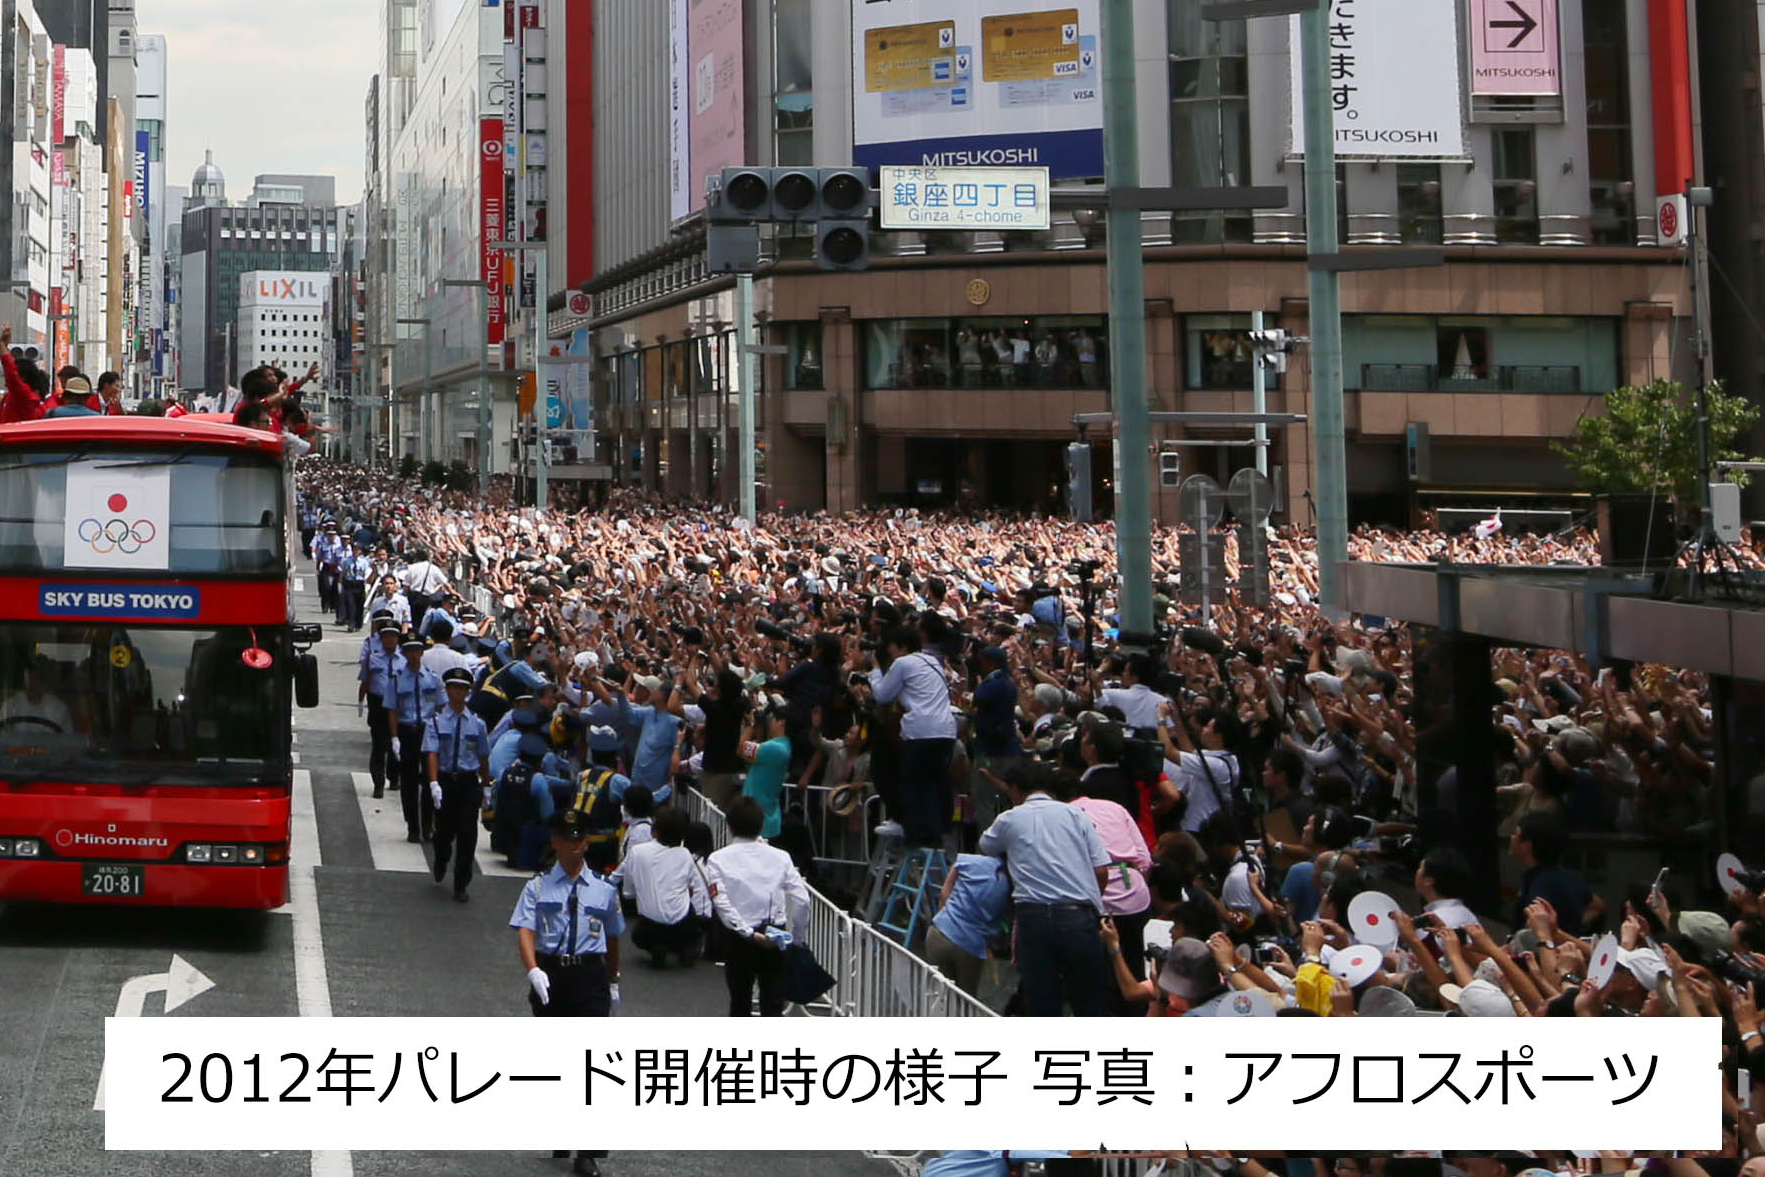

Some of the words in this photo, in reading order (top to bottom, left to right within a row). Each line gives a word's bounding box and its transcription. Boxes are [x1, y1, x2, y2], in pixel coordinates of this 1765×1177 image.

[1055, 63, 1077, 73] VISA
[1476, 68, 1556, 78] MITSUKOSHI
[1073, 90, 1095, 100] VISA
[1335, 129, 1438, 143] ITSUKOSHI
[923, 147, 1038, 166] MITSUKOSHI
[134, 151, 145, 208] MIZUHO
[892, 168, 938, 180] 中央区
[892, 183, 1038, 208] 銀座四丁目
[908, 208, 949, 223] Ginza
[957, 208, 1023, 223] 4-chome
[260, 278, 317, 299] LIXIL
[44, 591, 82, 608] SKY
[87, 592, 126, 608] BUS
[129, 593, 193, 610] TOKYO
[114, 648, 127, 664] 2
[74, 832, 169, 848] Hinomaru
